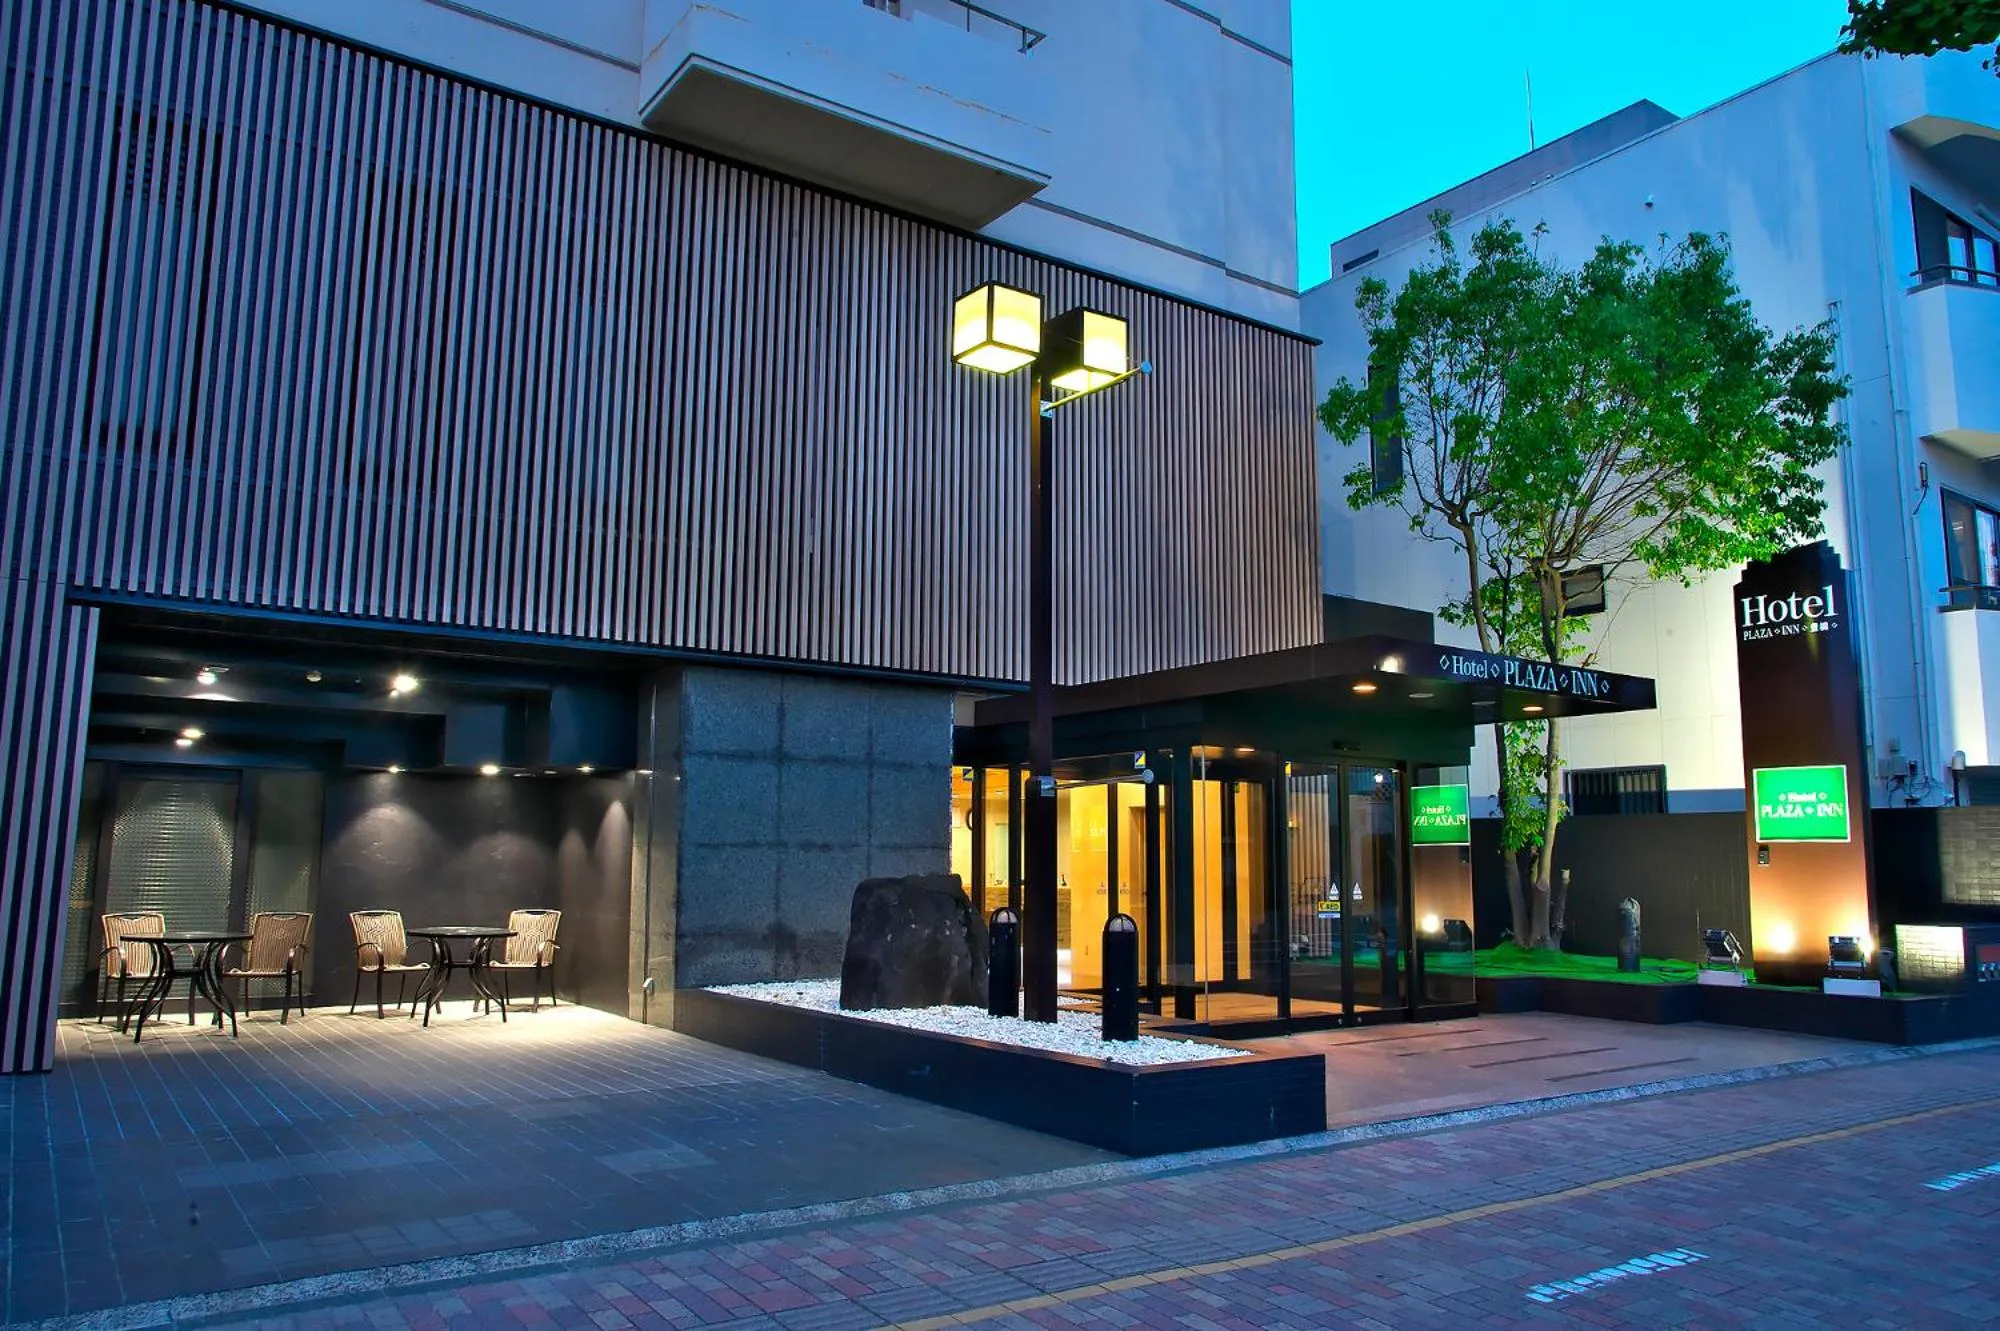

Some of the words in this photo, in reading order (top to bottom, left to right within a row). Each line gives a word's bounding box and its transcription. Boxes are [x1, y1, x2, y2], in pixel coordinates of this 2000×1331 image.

[1741, 584, 1839, 627] Hotel
[1743, 628, 1773, 641] PLAZA
[1781, 623, 1800, 636] INN
[1452, 655, 1488, 679] Hotel
[1504, 659, 1558, 692] PLAZA
[1571, 670, 1598, 697] INN
[1761, 803, 1805, 818] PLAZA
[1816, 802, 1843, 817] INN
